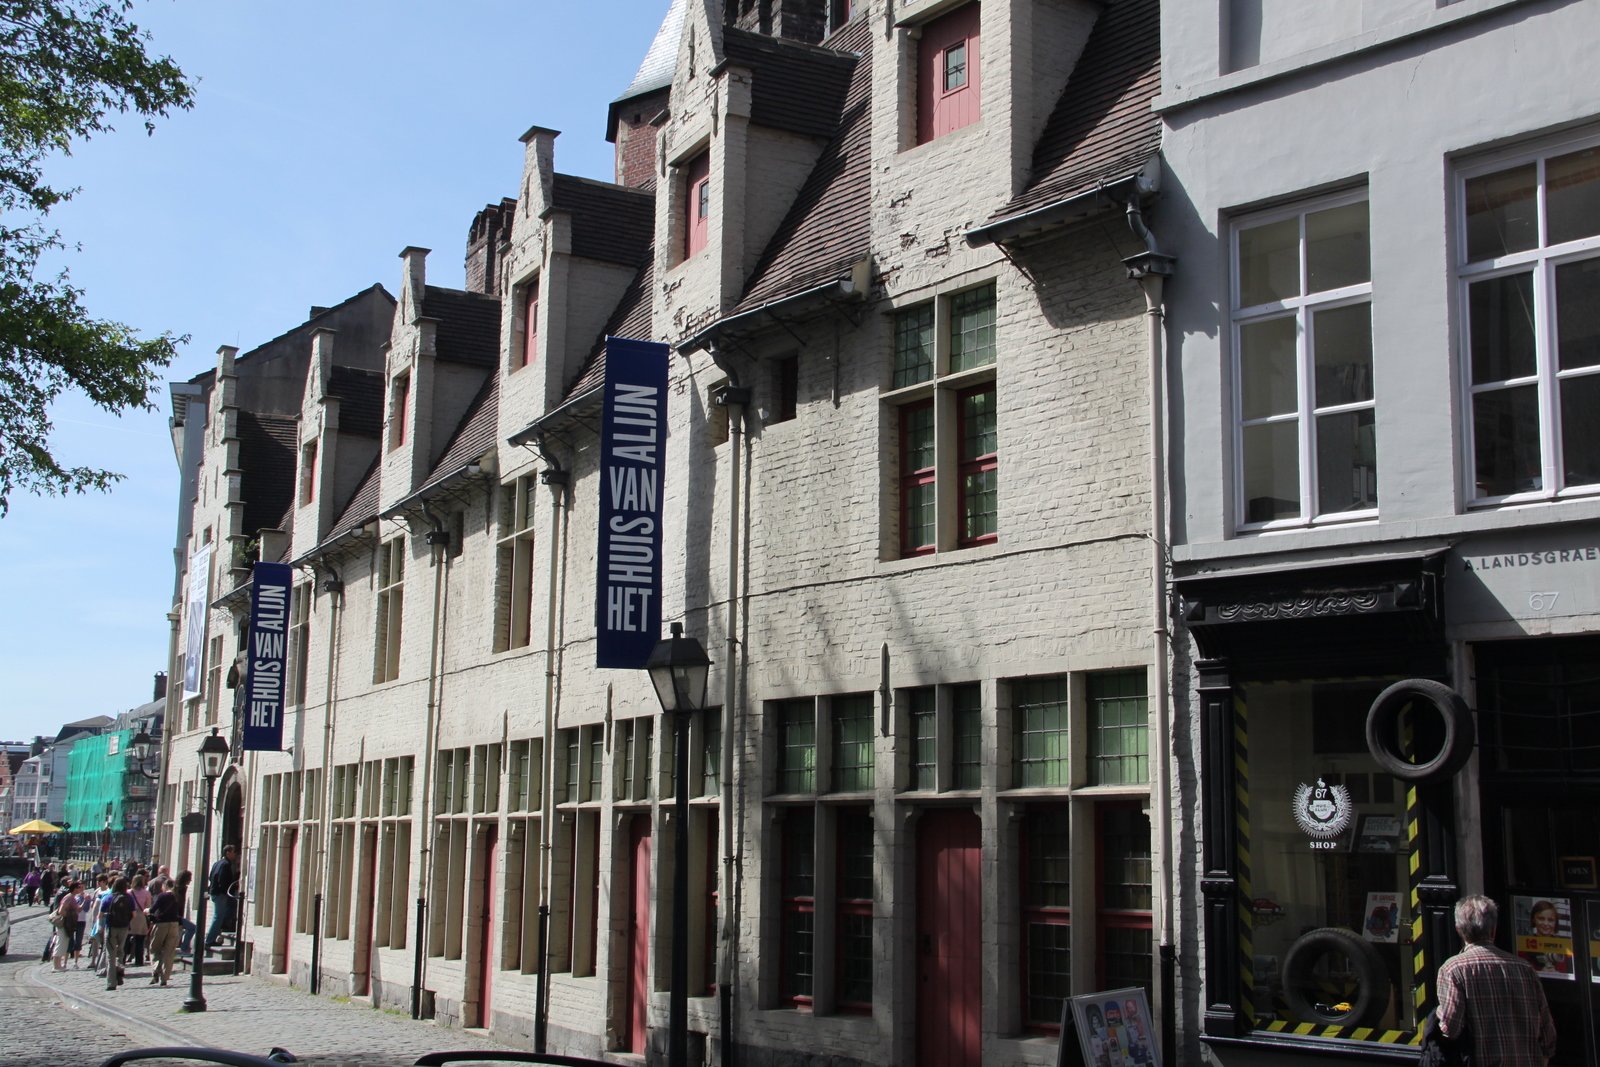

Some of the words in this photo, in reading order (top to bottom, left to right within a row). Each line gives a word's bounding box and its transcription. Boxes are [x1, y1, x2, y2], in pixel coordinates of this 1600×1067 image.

[612, 383, 658, 464] ALIJN
[609, 466, 657, 513] VAN
[608, 515, 655, 584] HUIS
[1464, 547, 1600, 572] A.LANDSGRAE
[257, 584, 286, 630] ALIJN
[607, 585, 652, 633] HET
[1528, 591, 1560, 612] 67
[254, 632, 284, 659] VAN
[252, 661, 282, 699] HUIS
[250, 701, 279, 727] HET
[1315, 788, 1327, 799] 67
[1309, 841, 1337, 849] SHOP
[1568, 867, 1589, 875] OPEN
